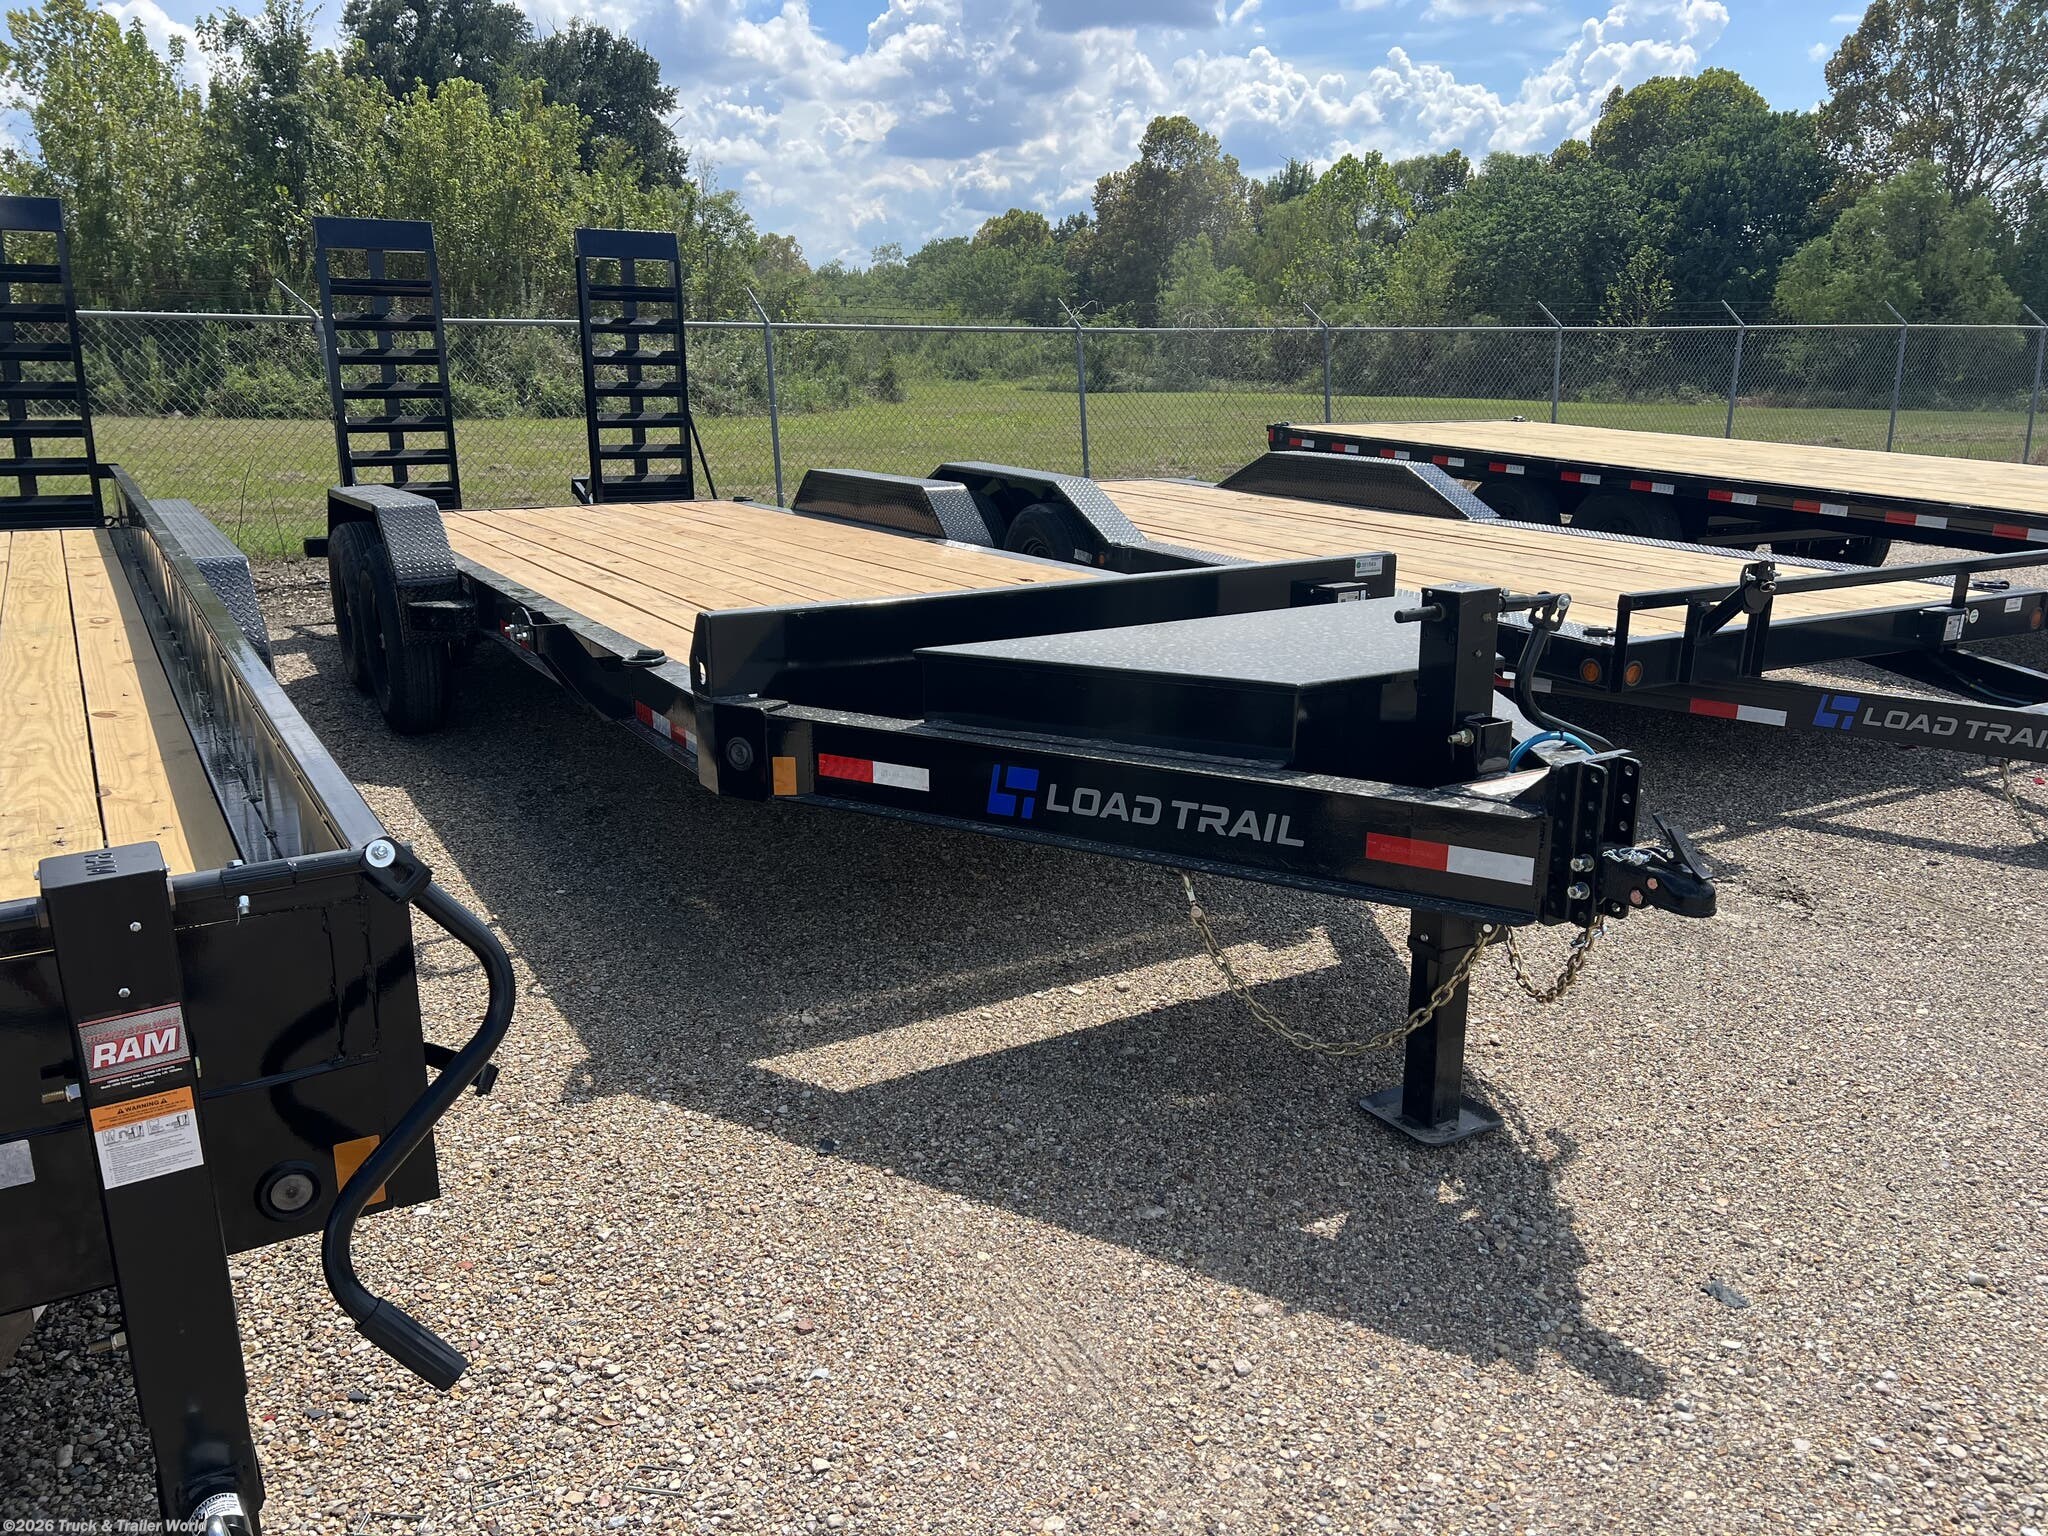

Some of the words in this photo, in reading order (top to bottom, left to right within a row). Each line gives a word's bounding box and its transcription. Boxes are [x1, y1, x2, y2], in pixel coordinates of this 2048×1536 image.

[1862, 706, 1958, 737] LOAD
[1965, 719, 2048, 751] TRAI
[1046, 783, 1162, 826] LOAD
[1171, 799, 1305, 848] TRAIL
[93, 1027, 178, 1069] RAM
[124, 1100, 160, 1113] WARNING
